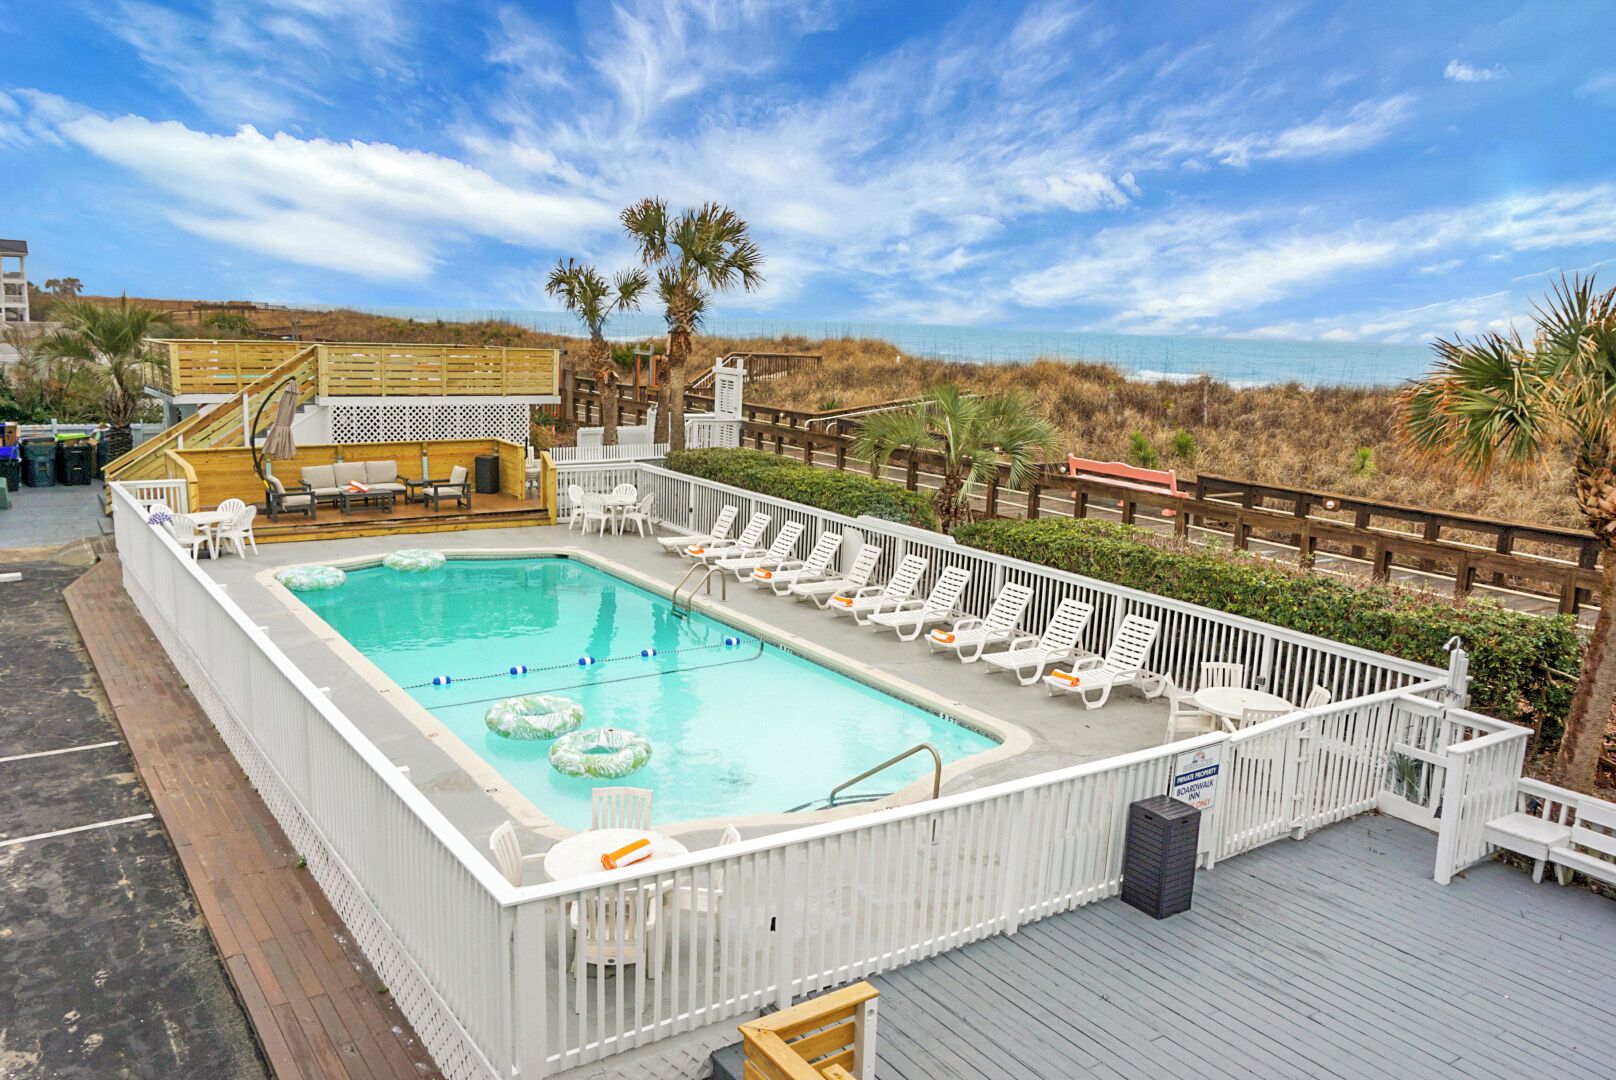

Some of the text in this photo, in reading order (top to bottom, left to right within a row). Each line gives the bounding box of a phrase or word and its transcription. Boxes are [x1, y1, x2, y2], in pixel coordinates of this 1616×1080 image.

[1177, 767, 1217, 784] PRIVATE PROPERTY
[1176, 779, 1214, 797] BOARDWALK
[1188, 791, 1201, 801] INN
[1195, 799, 1211, 809] ONLY
